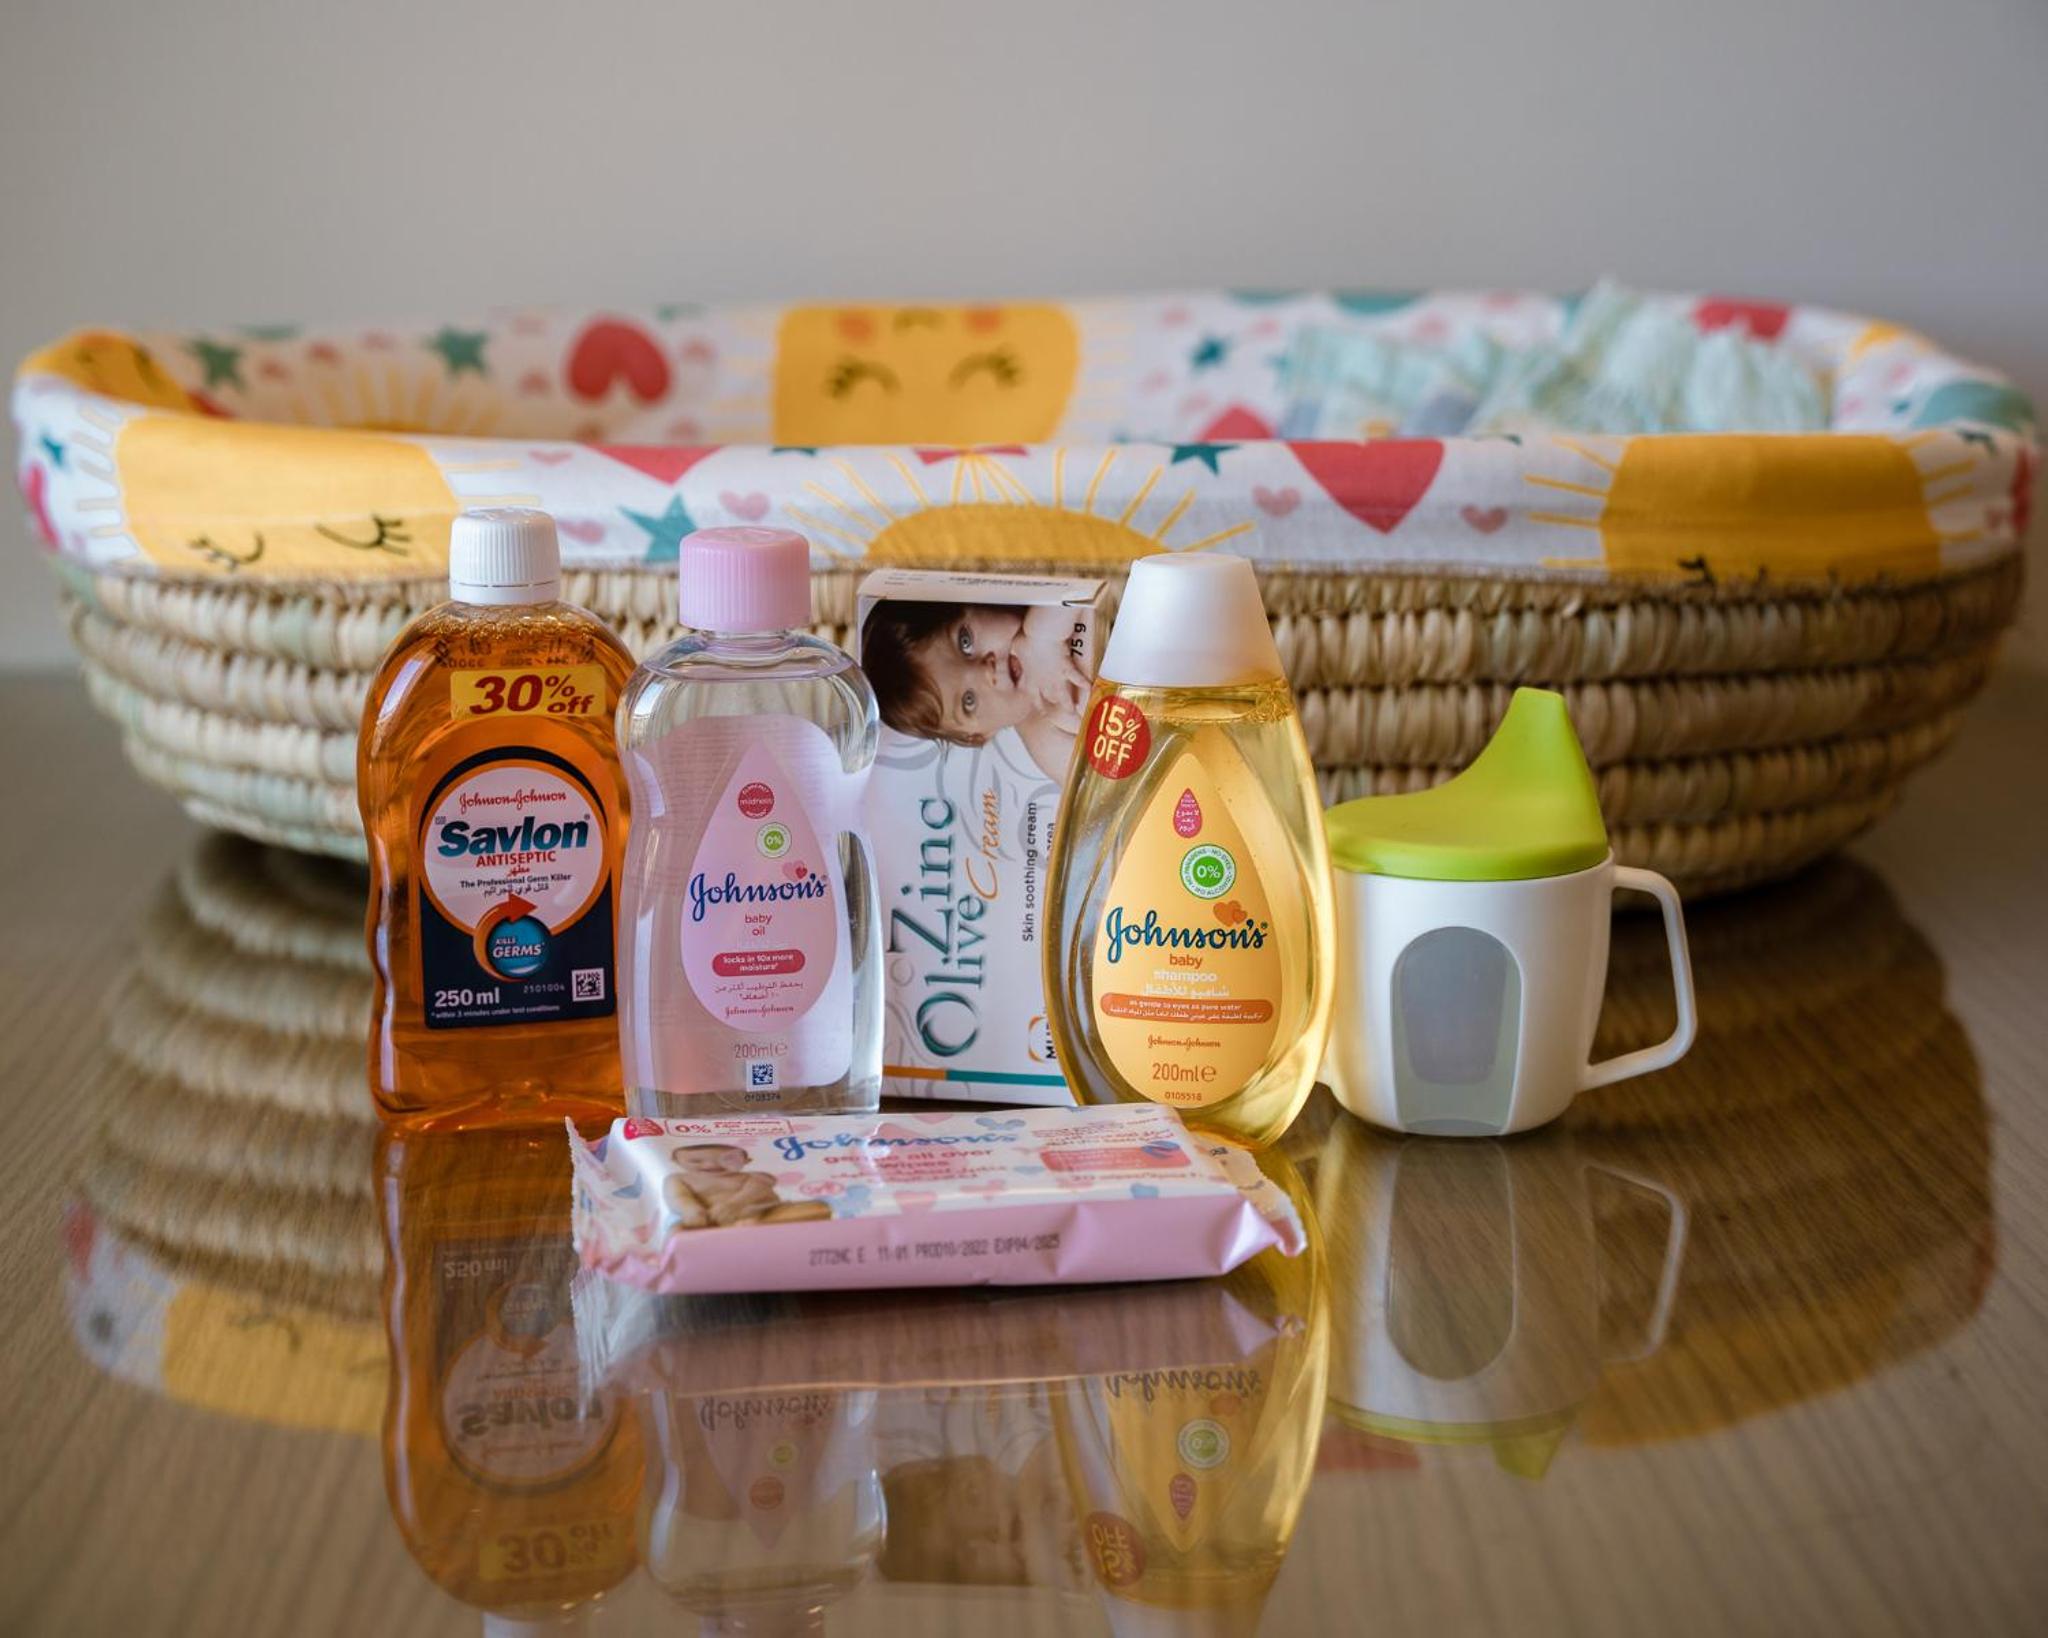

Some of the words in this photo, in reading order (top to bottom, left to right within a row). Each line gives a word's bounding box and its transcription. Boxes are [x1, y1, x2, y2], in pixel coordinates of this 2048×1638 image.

[1073, 622, 1086, 633] g
[1071, 638, 1085, 657] 75
[470, 674, 576, 715] 30%
[547, 694, 595, 715] off
[1099, 701, 1141, 743] 15%
[1093, 734, 1133, 766] OFF
[438, 815, 590, 858] Savlon
[1027, 802, 1038, 845] cream
[965, 789, 1000, 900] Cream
[476, 851, 557, 868] ANTISEPTIC
[1196, 864, 1221, 879] 0%
[460, 880, 475, 889] The
[477, 876, 525, 887] Professional
[550, 872, 572, 882] Killer
[887, 798, 955, 953] Zinc
[1024, 849, 1038, 909] soothing
[690, 872, 827, 922] Johnson's
[744, 912, 773, 926] baby
[751, 926, 767, 937] oil
[1023, 912, 1034, 942] Skin
[1105, 906, 1269, 964] Johnson's
[1168, 953, 1203, 969] baby
[916, 895, 985, 1057] Olive
[1153, 969, 1219, 984] shampoo
[434, 987, 474, 1008] 250
[476, 986, 500, 1006] ml
[907, 1150, 935, 1161] all
[941, 1149, 994, 1159] over
